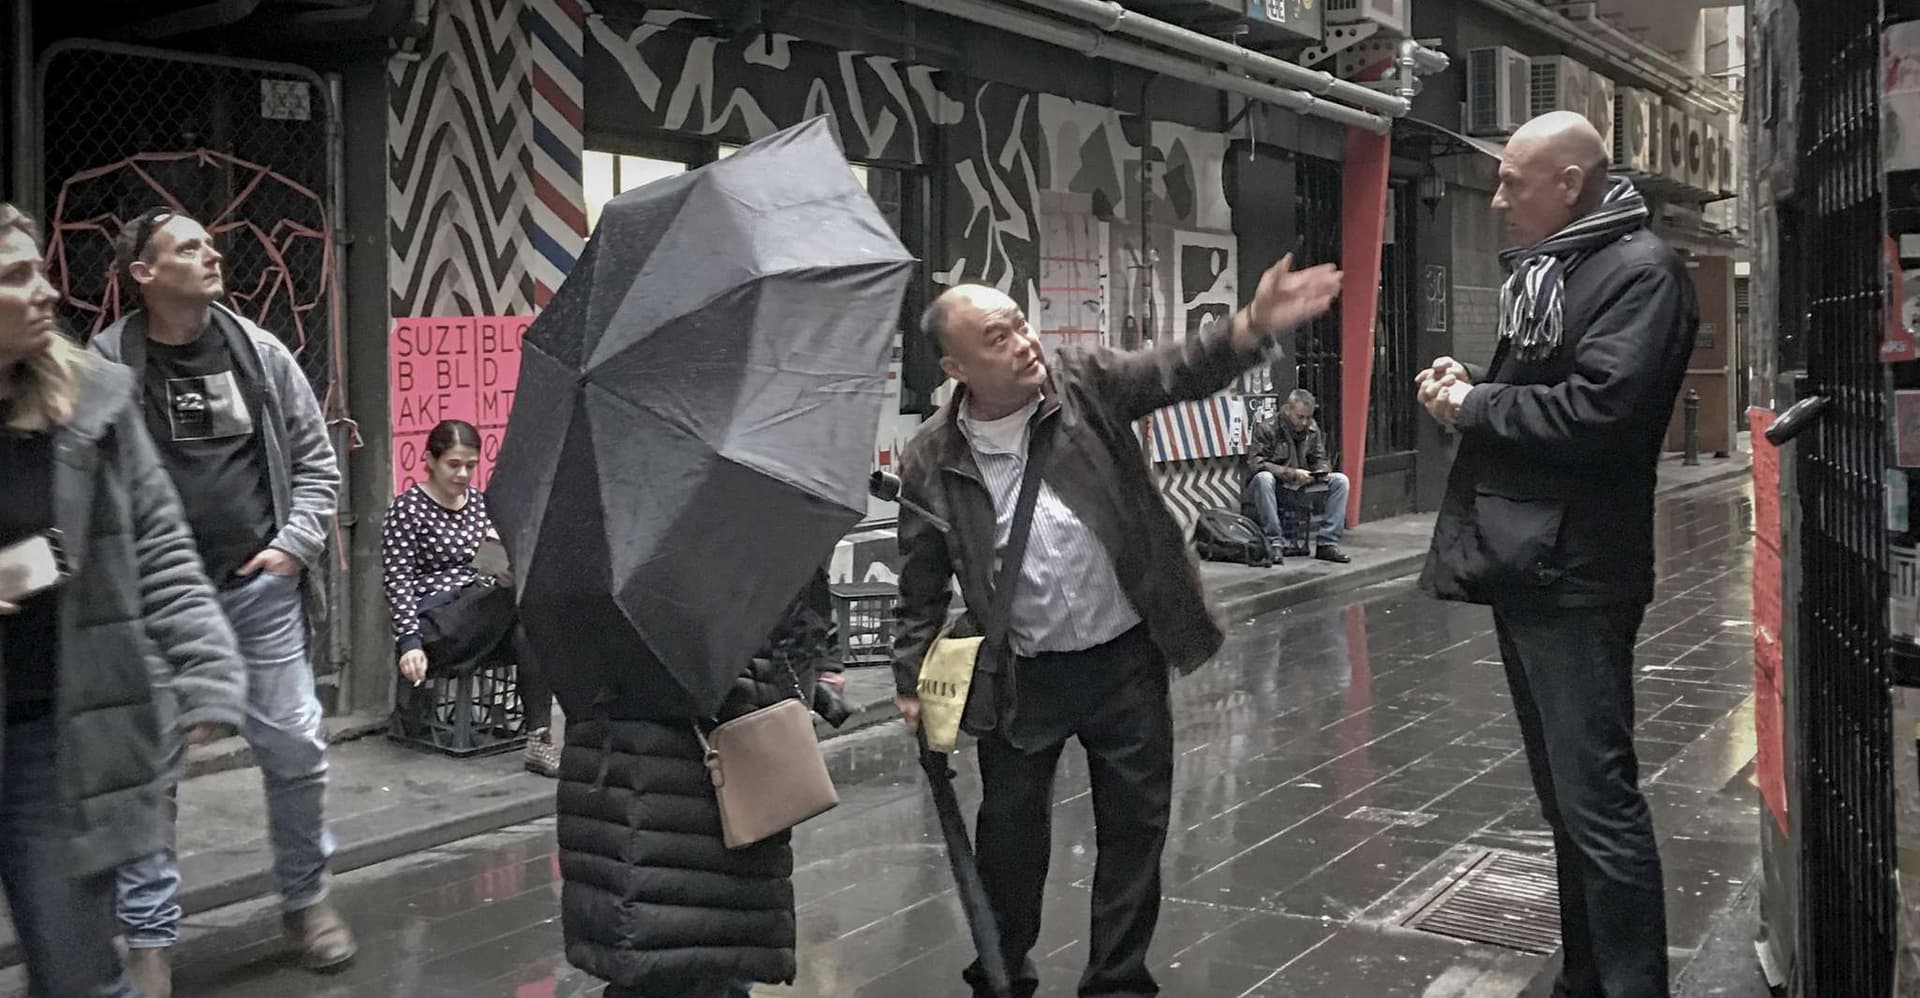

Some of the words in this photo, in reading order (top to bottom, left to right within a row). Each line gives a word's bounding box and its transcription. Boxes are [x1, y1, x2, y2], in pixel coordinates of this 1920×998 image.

[397, 325, 467, 357] SUZI
[398, 361, 414, 392] B
[436, 359, 470, 390] BL
[483, 357, 498, 387] D
